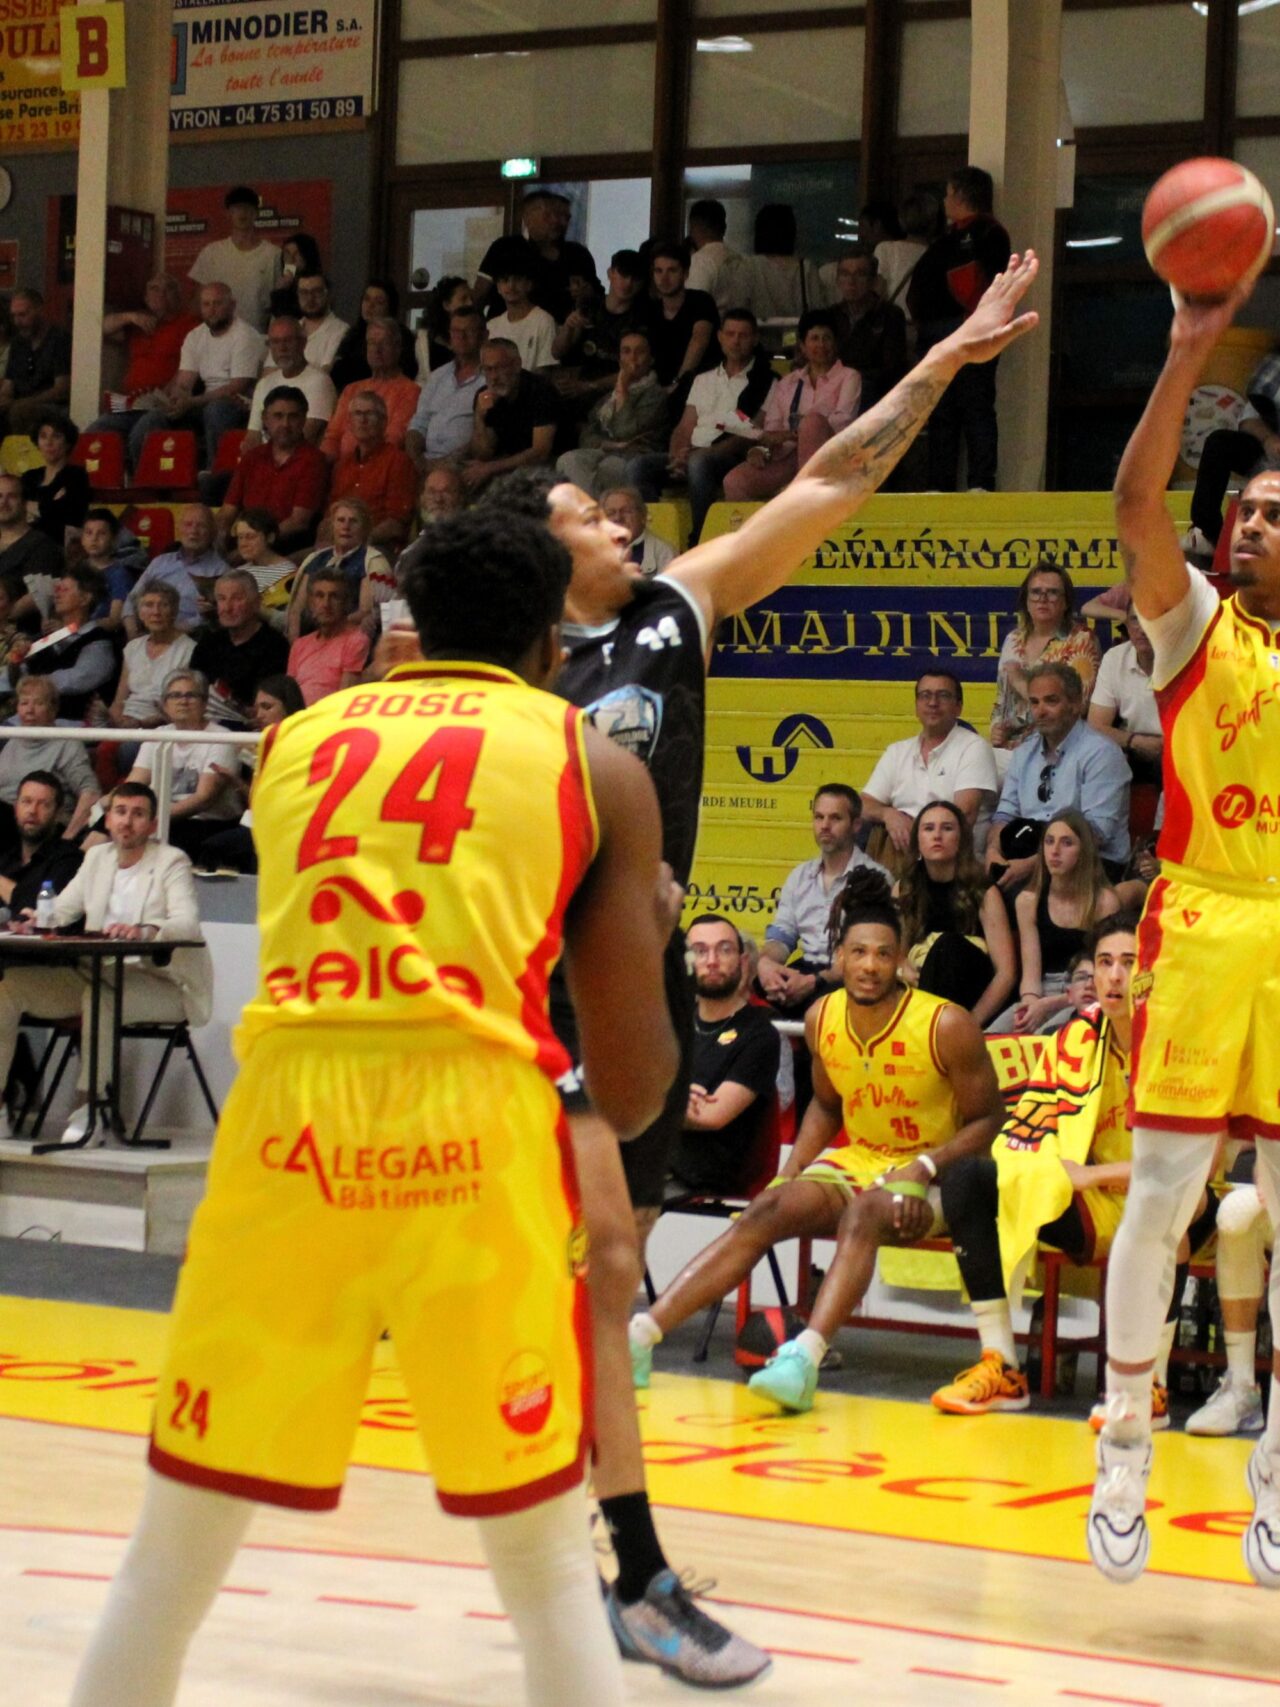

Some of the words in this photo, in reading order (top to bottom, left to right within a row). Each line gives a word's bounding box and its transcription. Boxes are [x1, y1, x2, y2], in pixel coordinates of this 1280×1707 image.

[191, 10, 328, 44] MINODIER
[76, 16, 108, 78] B
[226, 74, 263, 92] toute
[235, 106, 256, 125] 04
[260, 104, 280, 122] 75
[285, 103, 302, 121] 31
[310, 101, 331, 119] 50
[334, 99, 356, 117] 89
[342, 691, 486, 719] BOSC
[296, 726, 486, 874] 24
[729, 797, 777, 809] MEUBLE
[260, 1123, 484, 1204] CALEGARI
[338, 1180, 481, 1211] Bâtiment
[169, 1378, 210, 1441] 24
